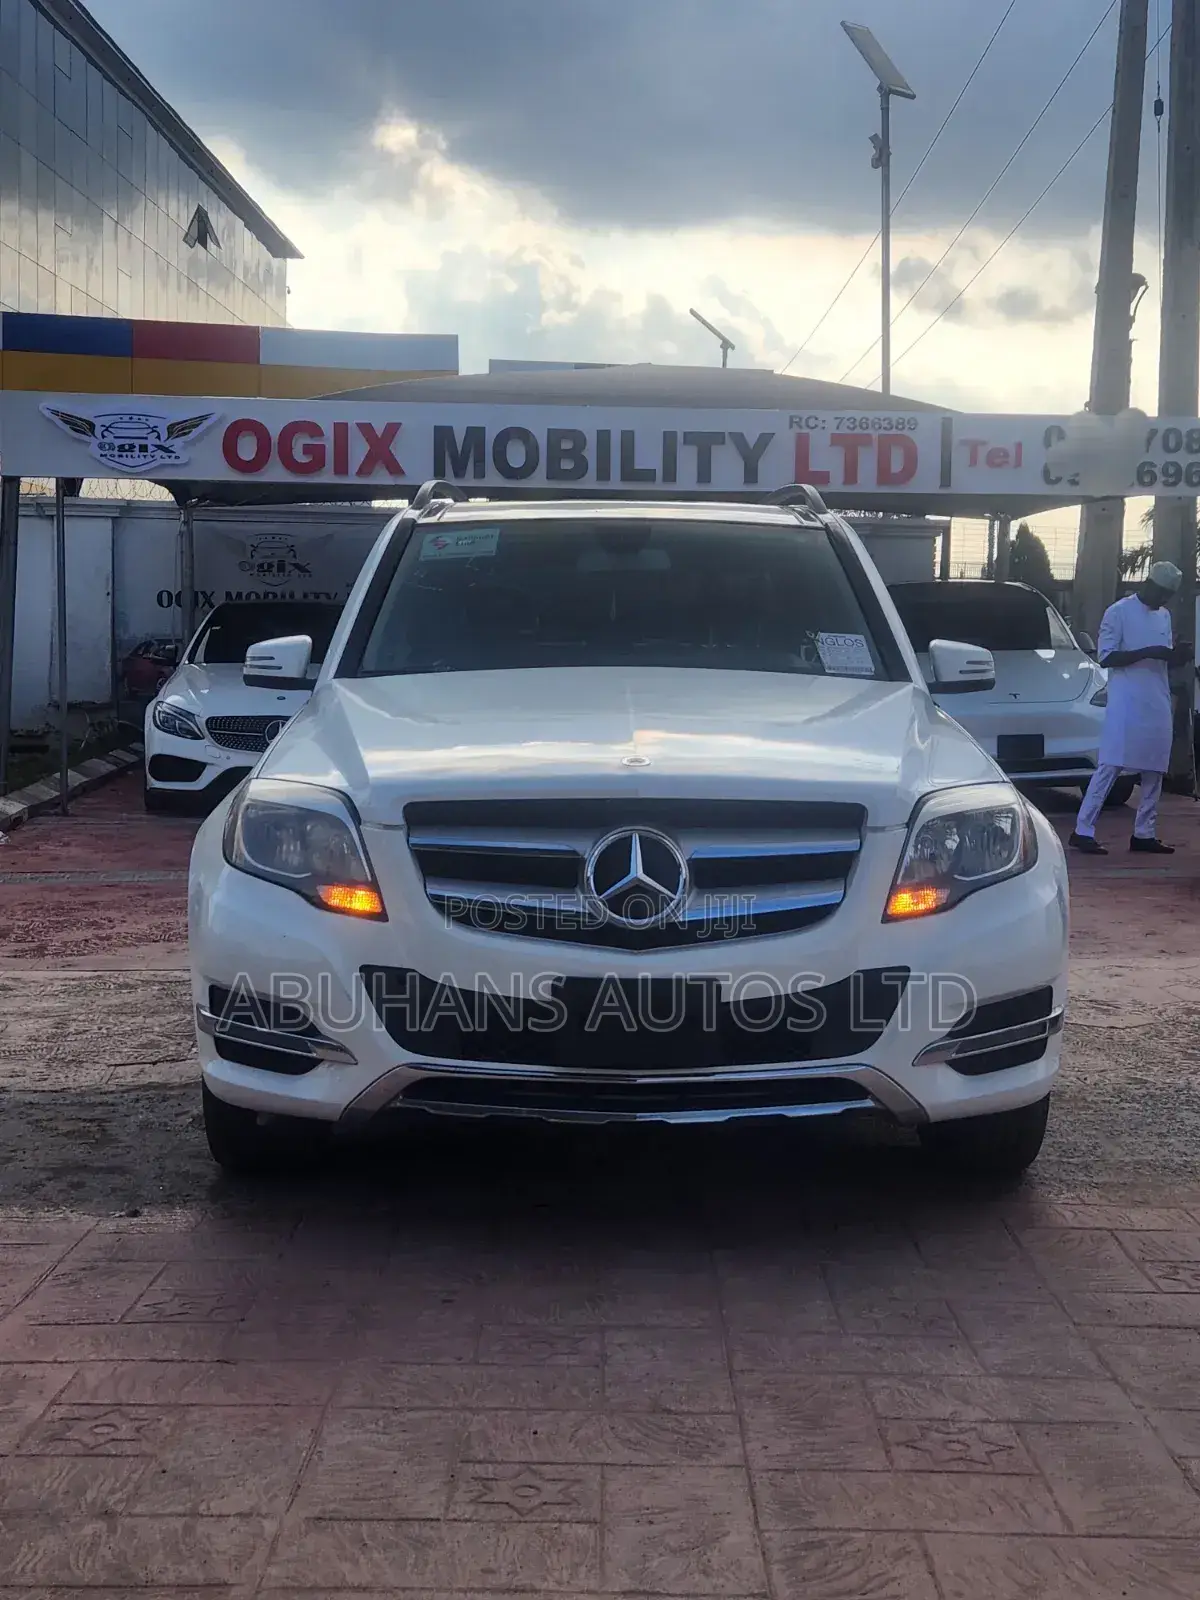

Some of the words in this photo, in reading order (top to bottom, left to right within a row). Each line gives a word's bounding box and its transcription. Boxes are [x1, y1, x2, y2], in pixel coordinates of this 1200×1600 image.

[788, 415, 827, 430] RC:
[834, 416, 919, 431] 7366389
[222, 418, 406, 476] OGIX
[433, 425, 776, 484] MOBILITY
[794, 432, 918, 486] LTD
[959, 438, 1023, 469] Tel
